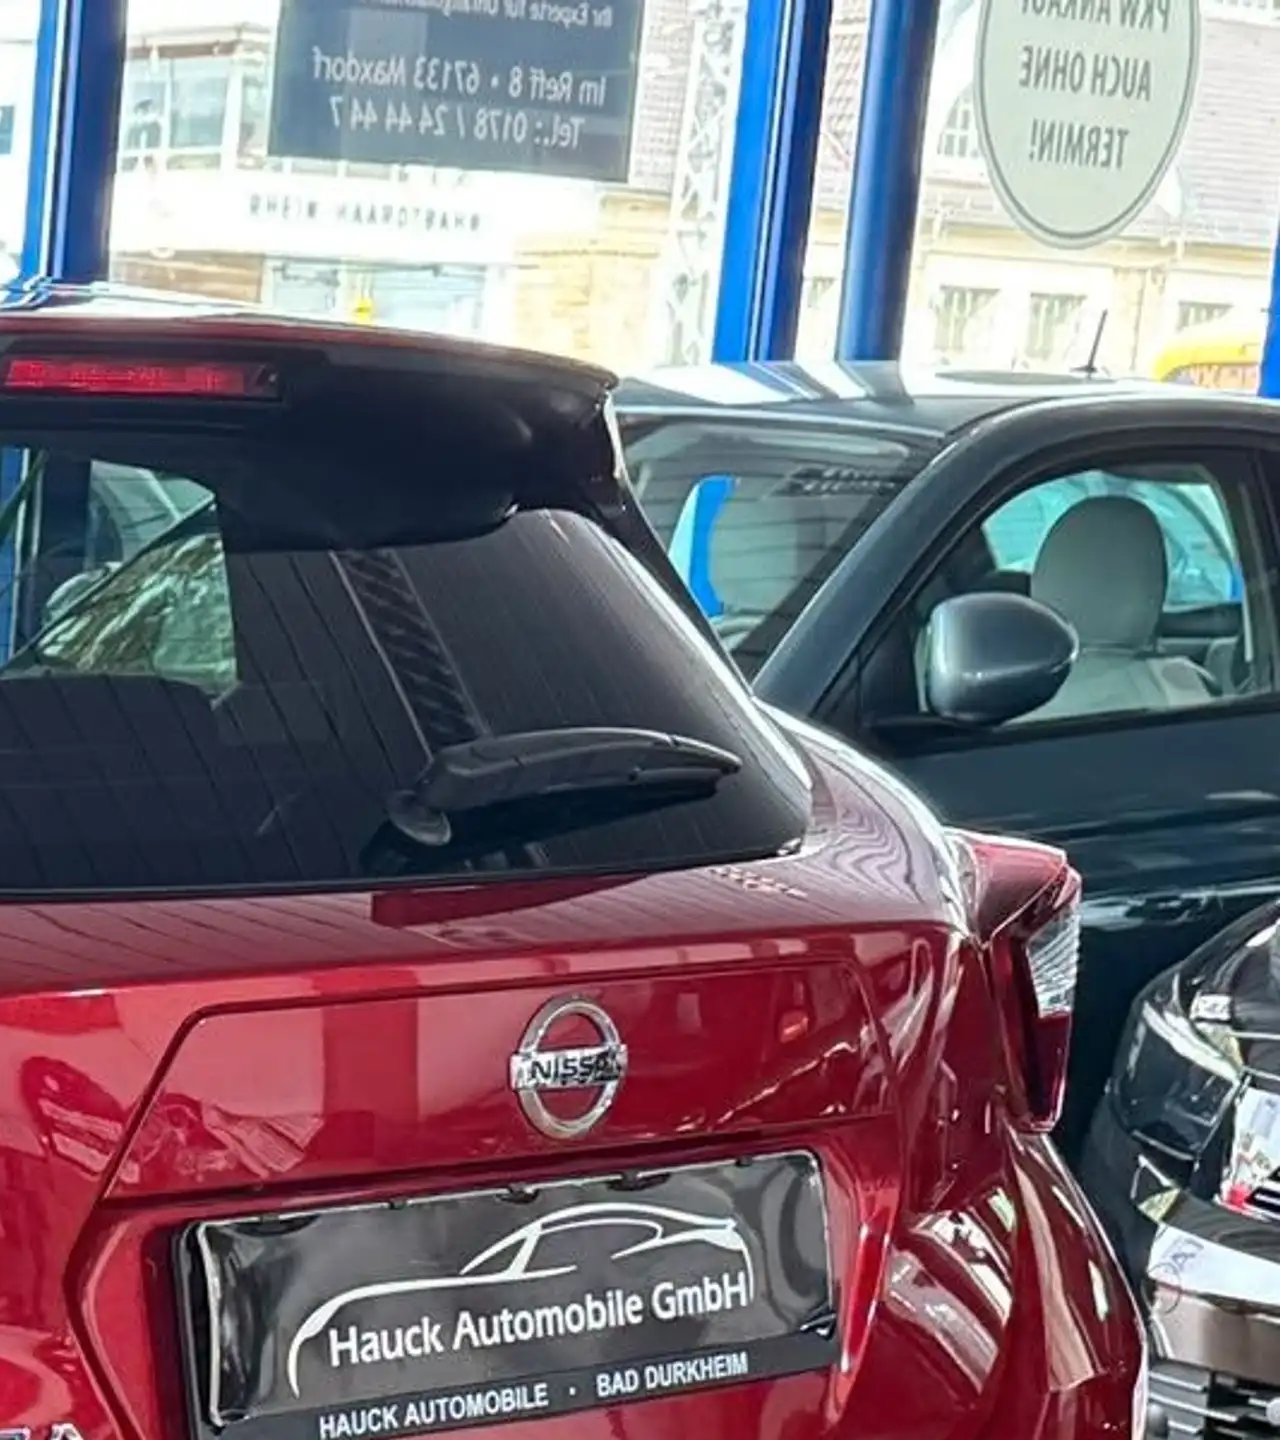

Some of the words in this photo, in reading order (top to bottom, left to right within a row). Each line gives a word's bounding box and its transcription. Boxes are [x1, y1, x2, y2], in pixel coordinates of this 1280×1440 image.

[329, 1321, 443, 1367] Hauck
[454, 1292, 643, 1350] Automobile
[652, 1273, 748, 1318] GmbH
[319, 1404, 399, 1440] HAUCK
[405, 1383, 549, 1426] AUTOMOBILE
[596, 1370, 639, 1397] BAD
